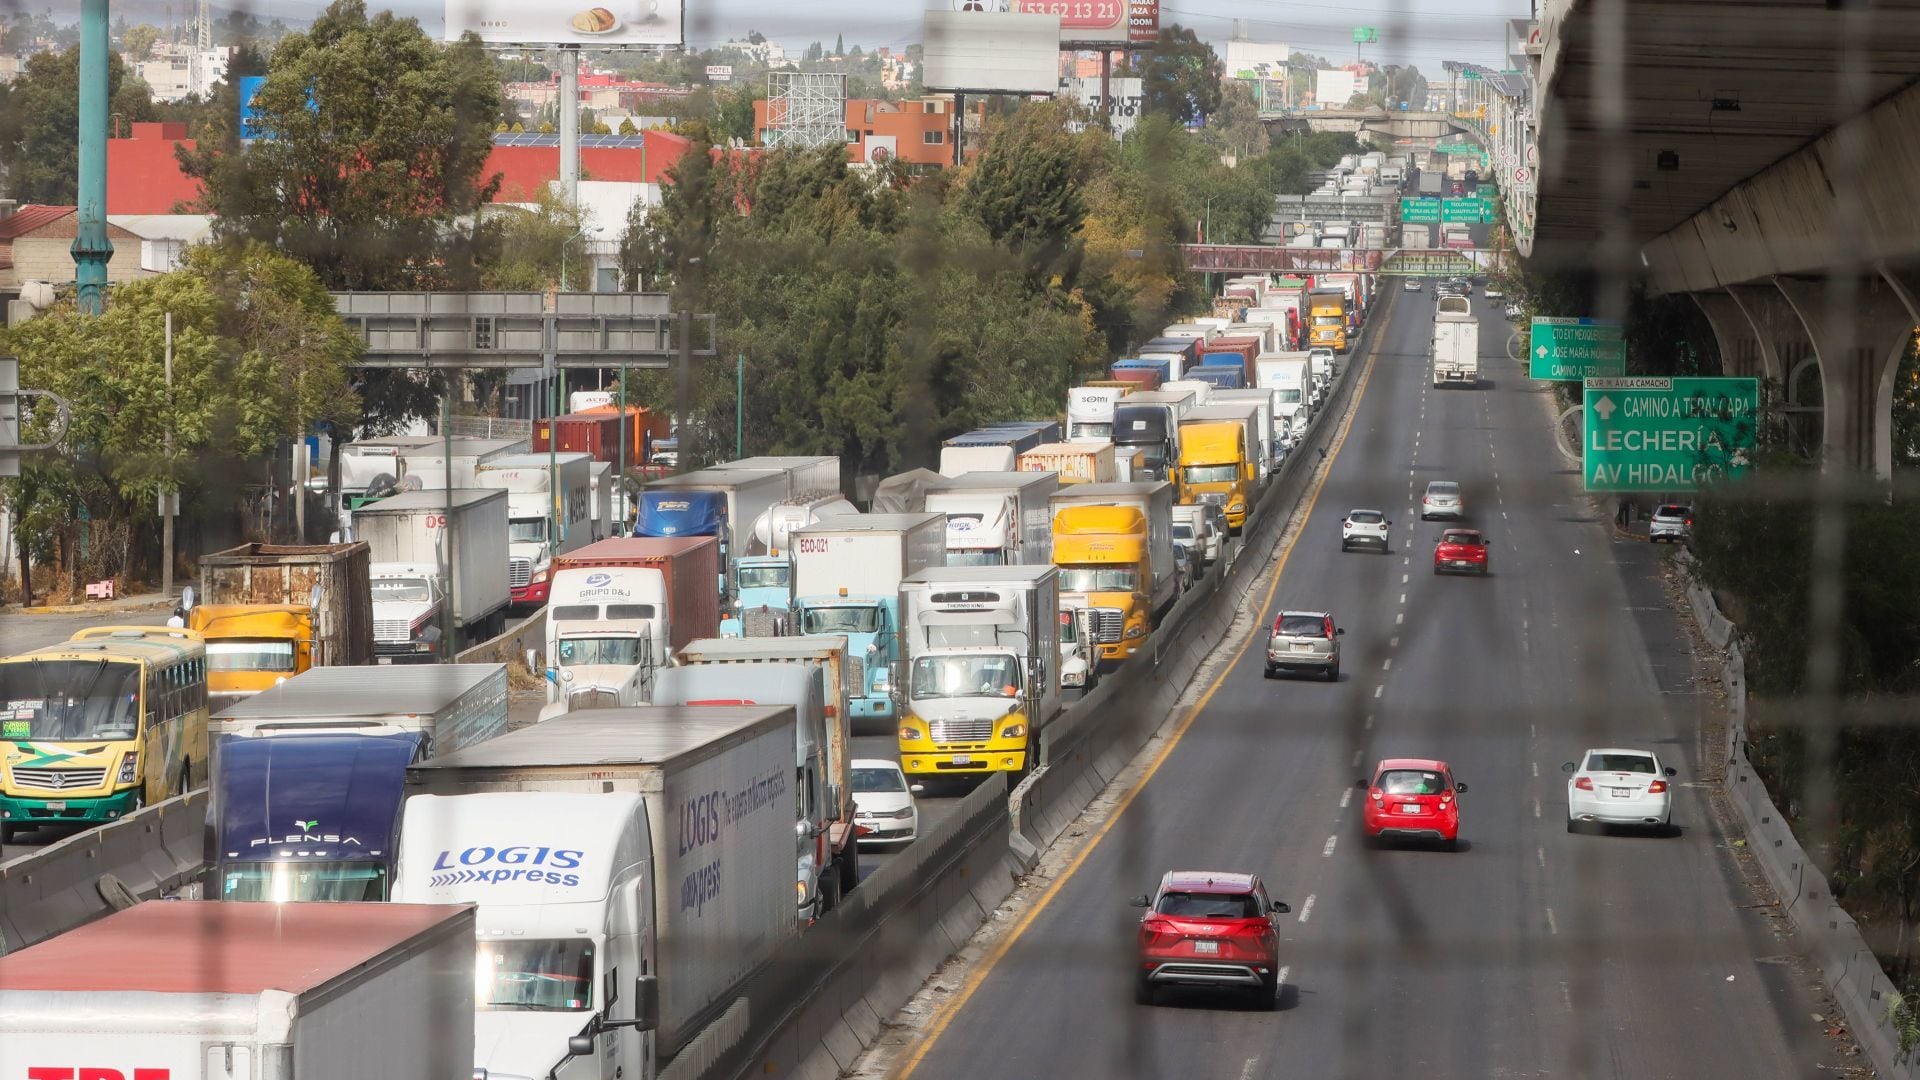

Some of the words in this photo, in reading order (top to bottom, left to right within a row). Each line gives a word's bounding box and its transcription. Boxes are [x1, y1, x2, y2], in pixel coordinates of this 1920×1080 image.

[1027, 3, 1045, 14] 53
[1050, 3, 1068, 18] 62
[1074, 3, 1092, 18] 13
[1097, 3, 1115, 18] 21
[1552, 328, 1563, 340] CTO
[1564, 328, 1574, 340] EXT
[1552, 344, 1568, 358] JOSÉ
[1569, 344, 1589, 359] MARÍA
[1551, 364, 1577, 377] CAMINO
[1578, 364, 1584, 376] A
[1615, 377, 1635, 388] ÁVILA
[1636, 379, 1669, 388] CAMACHO
[1623, 397, 1670, 418] CAMINO
[1672, 398, 1681, 417] A
[1592, 425, 1723, 451] LECHERÍA
[1593, 463, 1622, 484] AV
[800, 538, 829, 553] ECO-021
[579, 588, 609, 598] GRUPO
[611, 588, 631, 597] D&J
[679, 790, 720, 858] LOGIS
[432, 846, 584, 871] LOGIS
[473, 869, 580, 887] xpress
